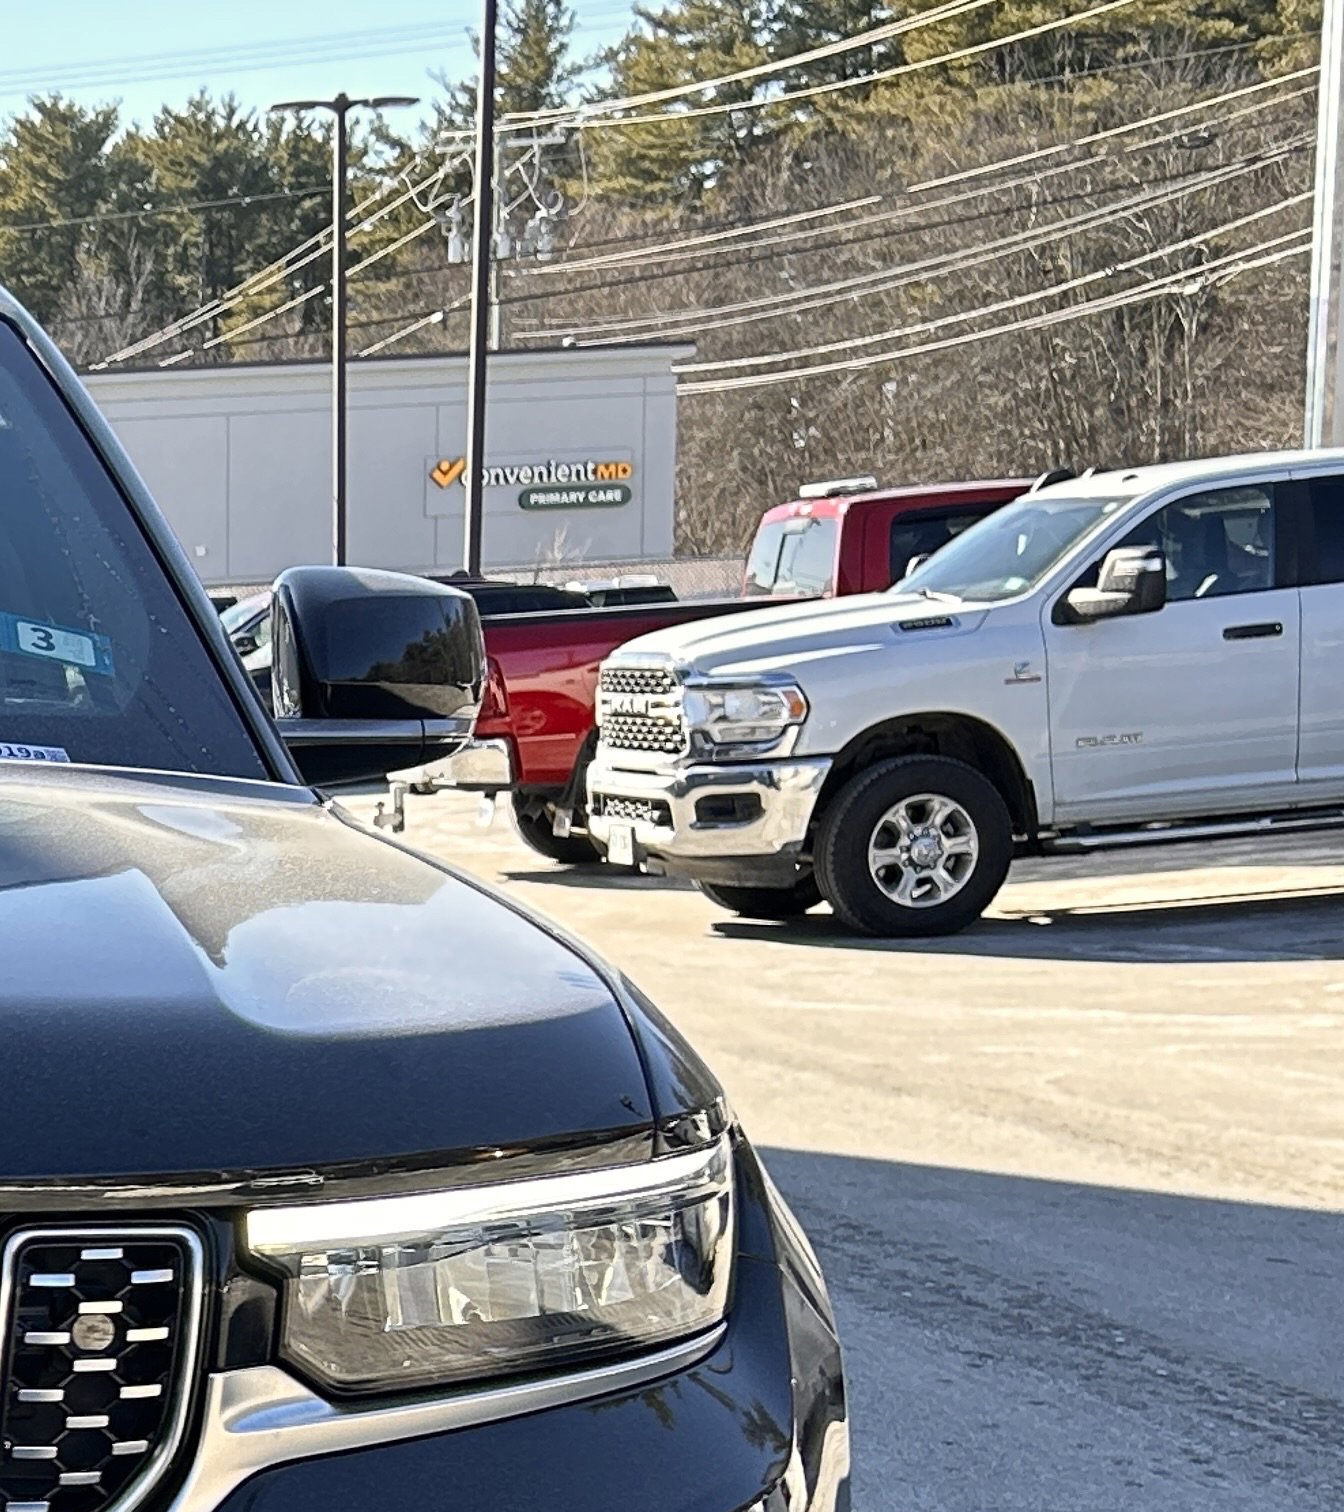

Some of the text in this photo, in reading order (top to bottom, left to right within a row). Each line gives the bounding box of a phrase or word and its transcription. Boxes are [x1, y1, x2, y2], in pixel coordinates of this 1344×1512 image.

[529, 488, 623, 505] PRIMARY CARE
[30, 627, 56, 652] 3
